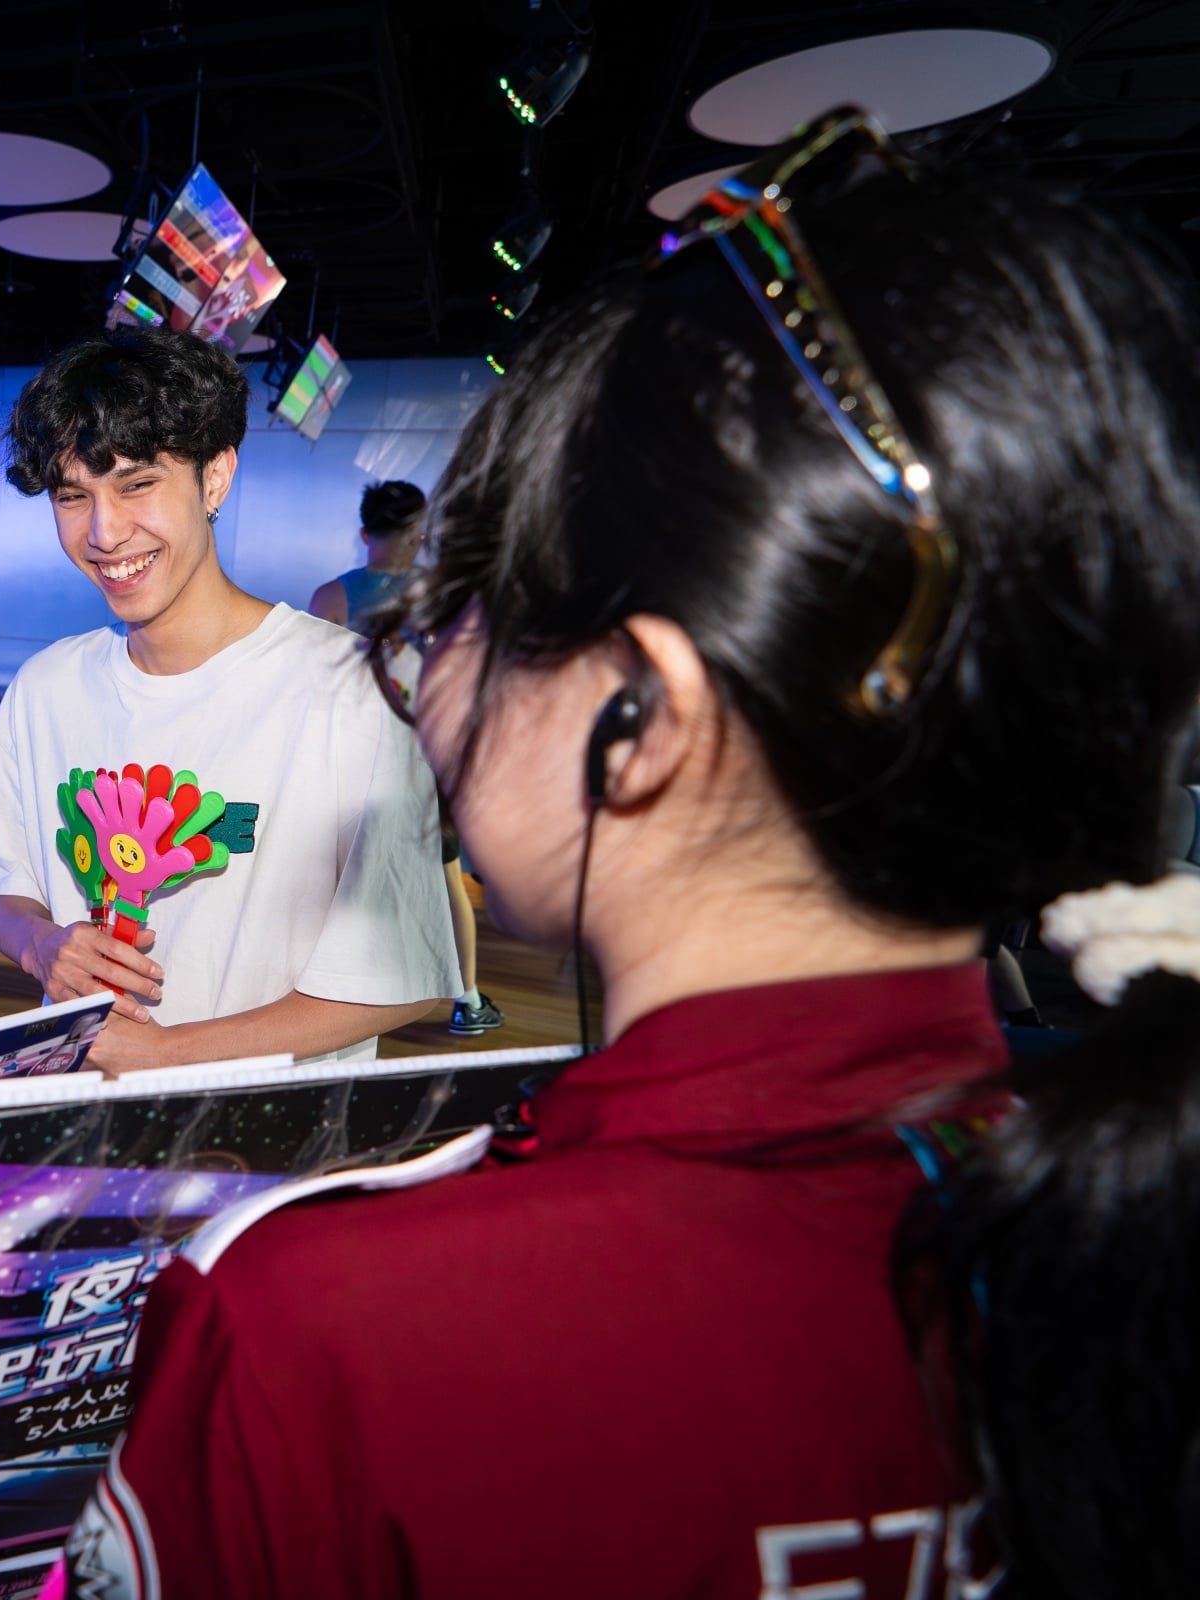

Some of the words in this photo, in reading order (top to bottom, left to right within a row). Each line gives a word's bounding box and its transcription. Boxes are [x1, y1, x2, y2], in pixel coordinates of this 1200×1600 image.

[40, 1249, 169, 1329] 夜
[25, 1403, 136, 1441] 5人以上
